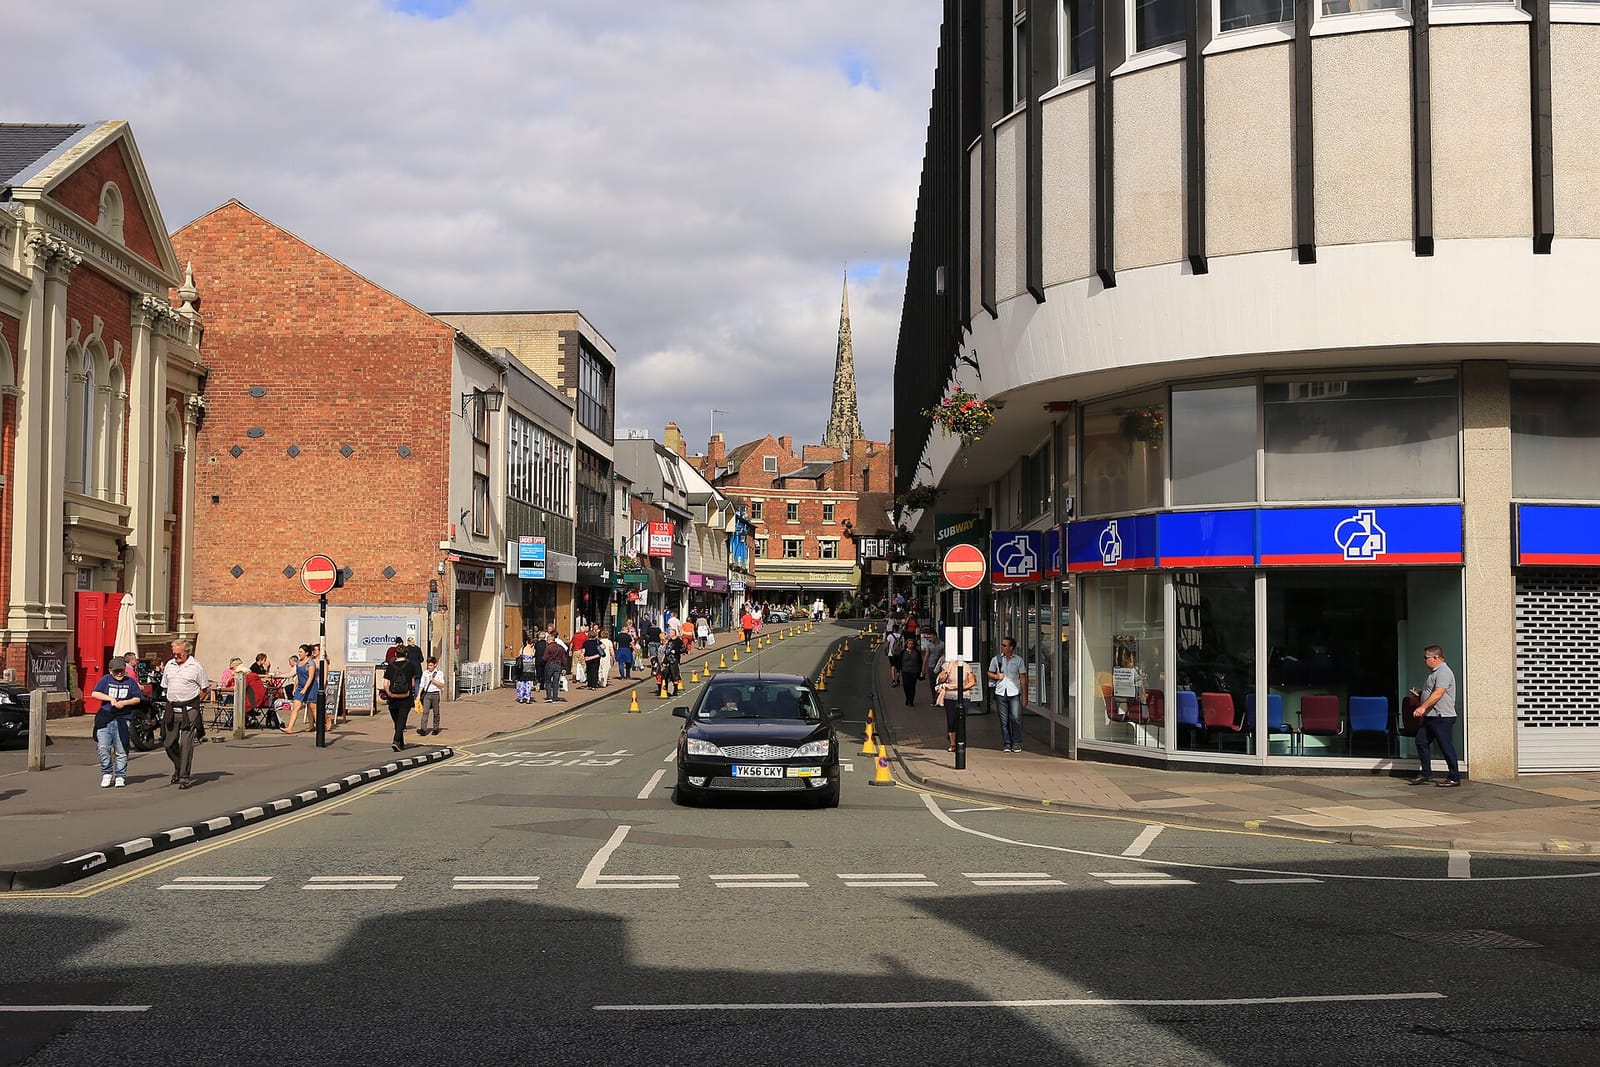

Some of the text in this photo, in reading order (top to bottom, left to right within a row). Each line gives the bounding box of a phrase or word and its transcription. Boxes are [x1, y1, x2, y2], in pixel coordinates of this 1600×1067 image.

[45, 214, 97, 254] CLAREMONT
[101, 247, 131, 276] BAPTIST
[655, 523, 669, 531] TSR
[937, 520, 976, 541] SUBWAY
[472, 749, 636, 758] TURN
[448, 758, 624, 767] RIGHT
[738, 766, 762, 776] YK56
[763, 767, 782, 776] CKY
